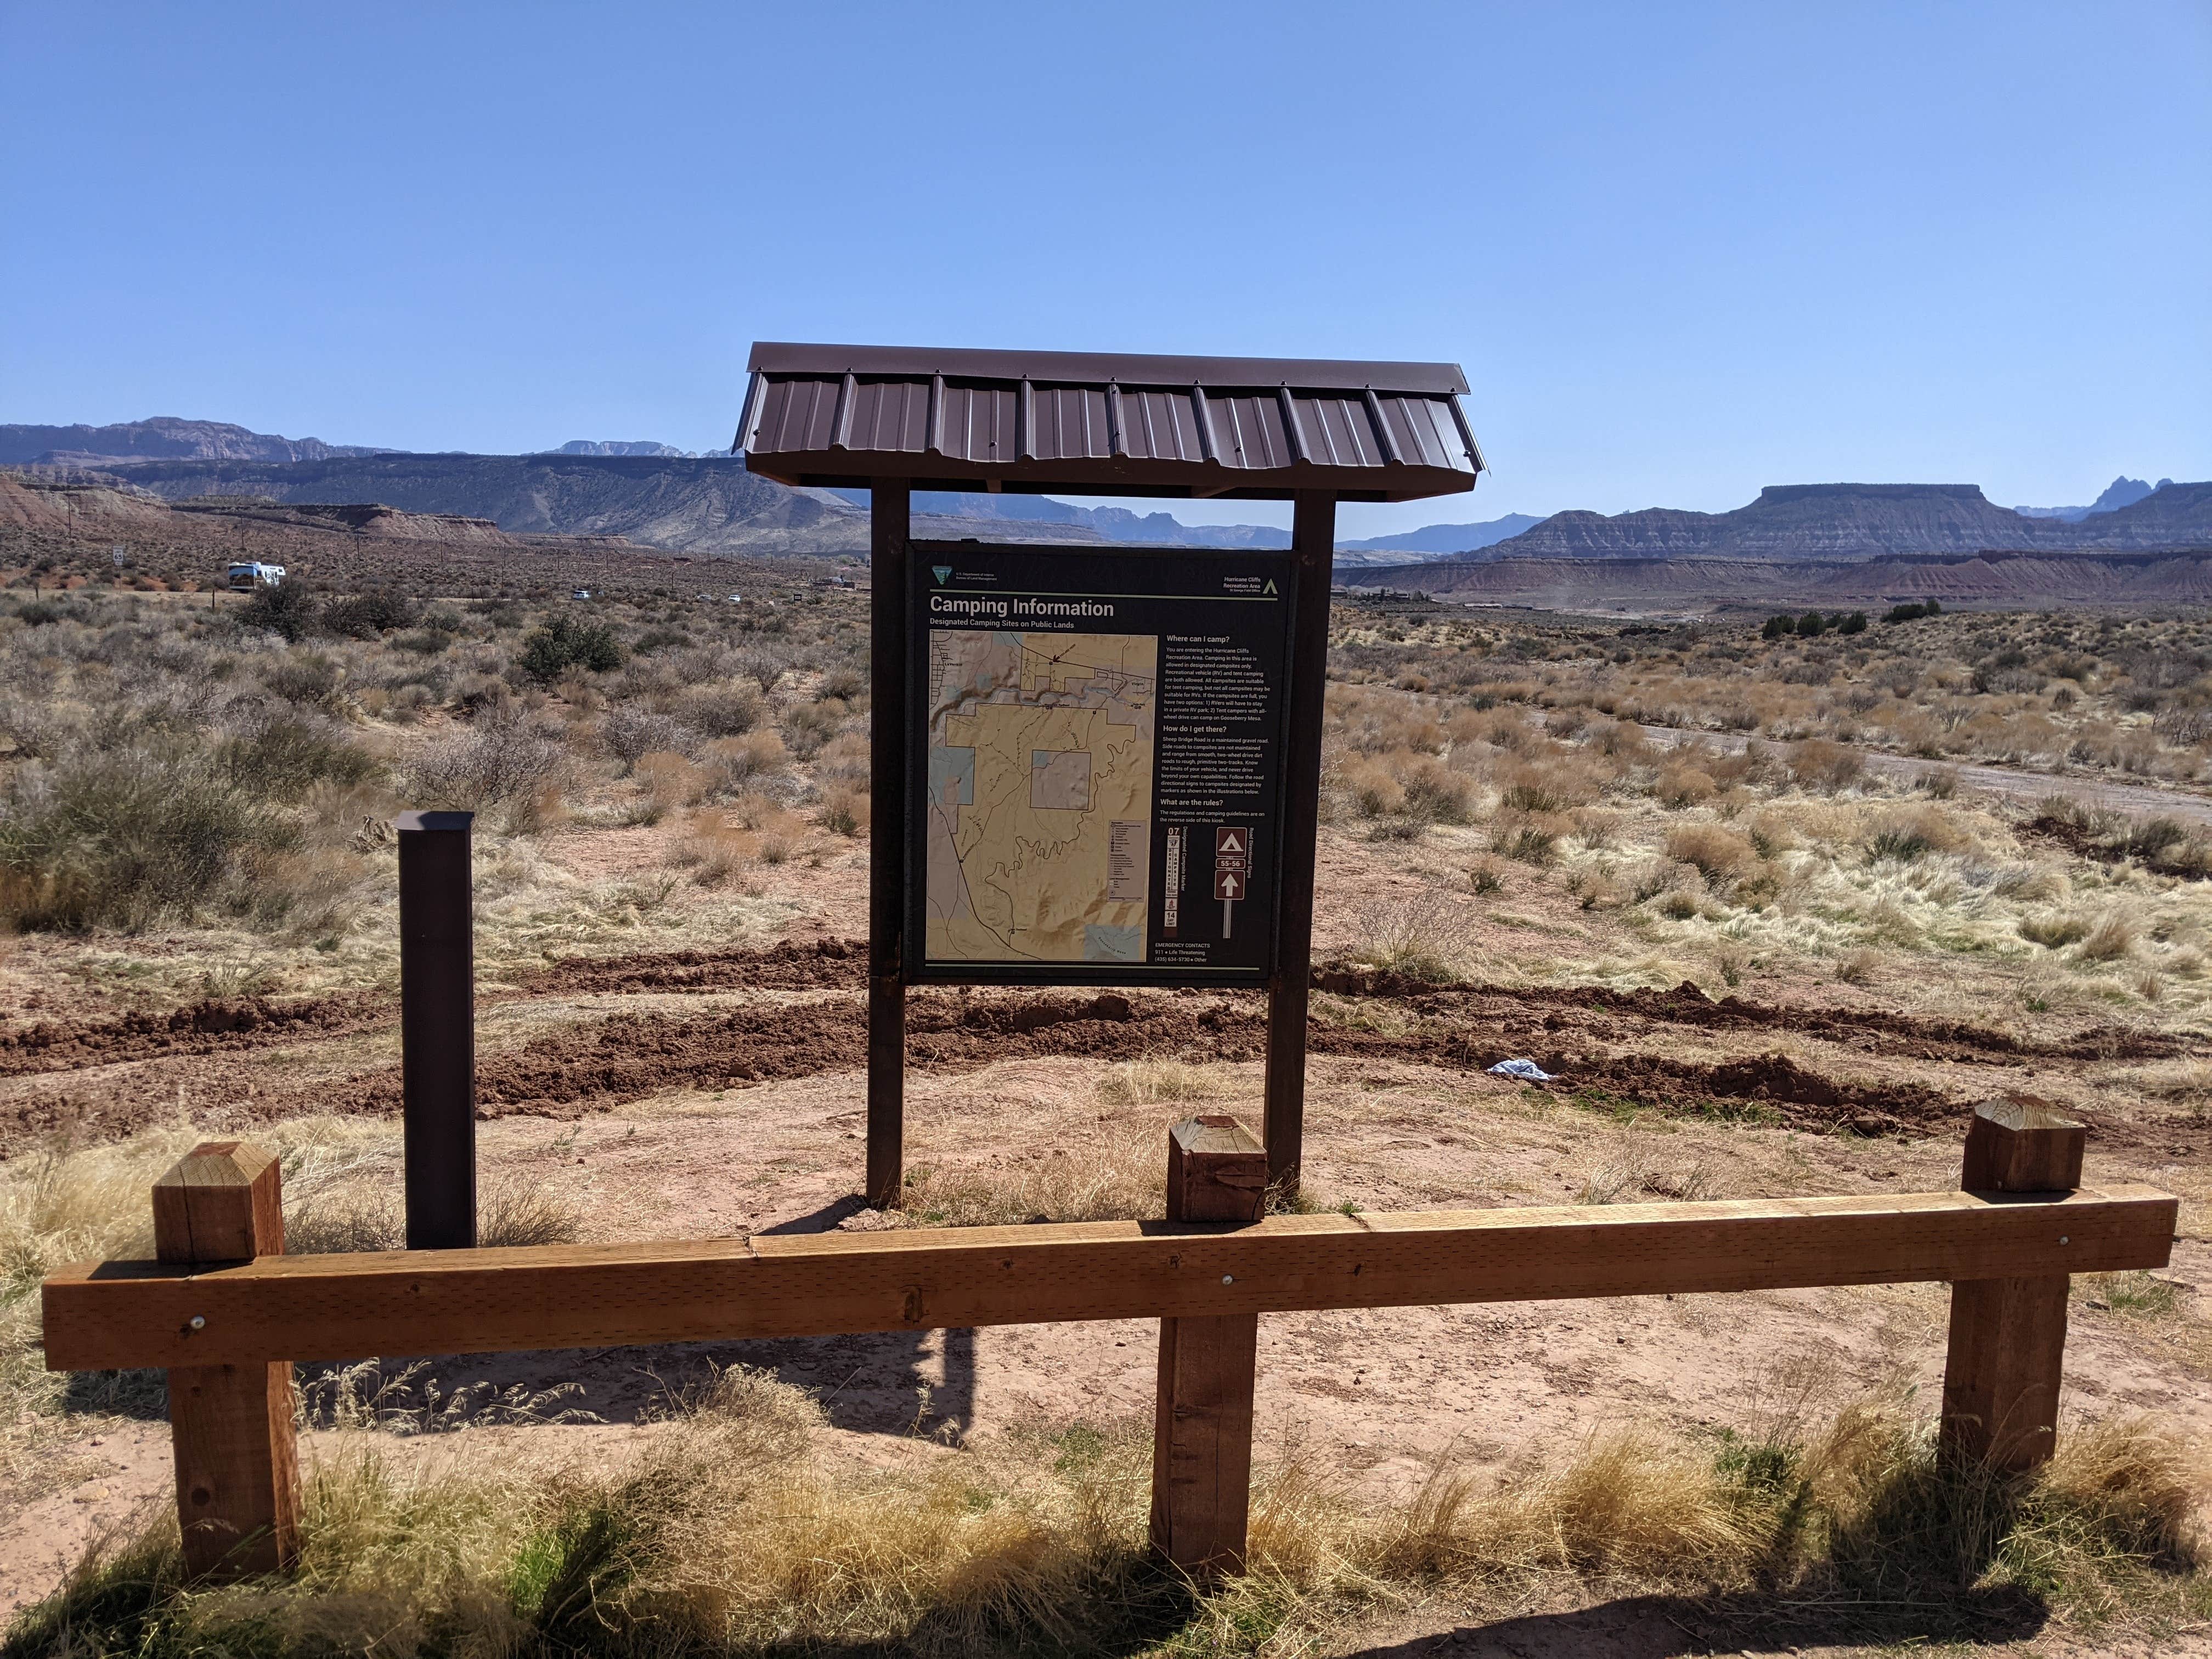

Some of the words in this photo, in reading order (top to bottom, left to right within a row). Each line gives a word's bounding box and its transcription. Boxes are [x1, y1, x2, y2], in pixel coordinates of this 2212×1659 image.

[930, 596, 1007, 617] Camping
[1014, 599, 1114, 616] Information
[930, 617, 968, 627] Designated
[969, 619, 1000, 628] Camping
[1207, 636, 1229, 644] camp?
